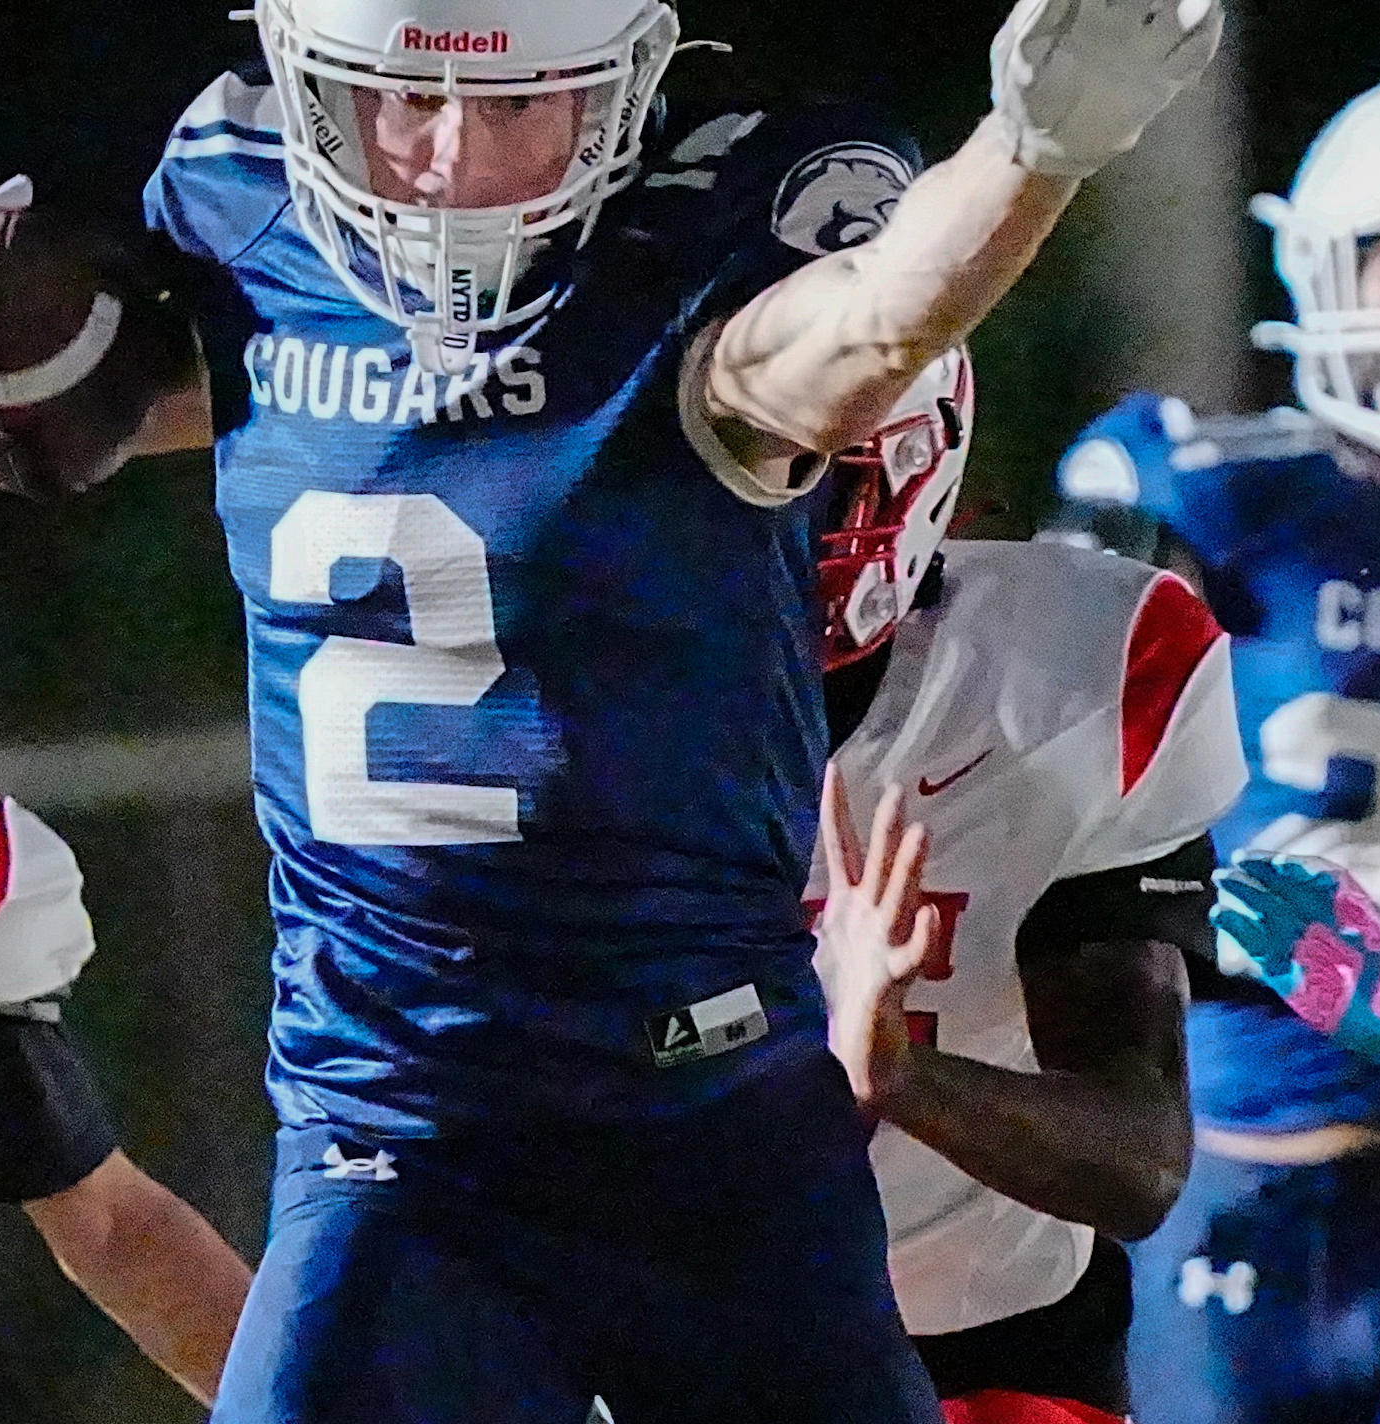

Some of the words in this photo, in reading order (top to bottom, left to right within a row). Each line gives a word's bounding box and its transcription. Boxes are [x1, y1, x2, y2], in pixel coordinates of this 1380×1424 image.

[403, 26, 508, 53] Riddell
[244, 335, 547, 426] COUGARS
[270, 489, 525, 847] 2
